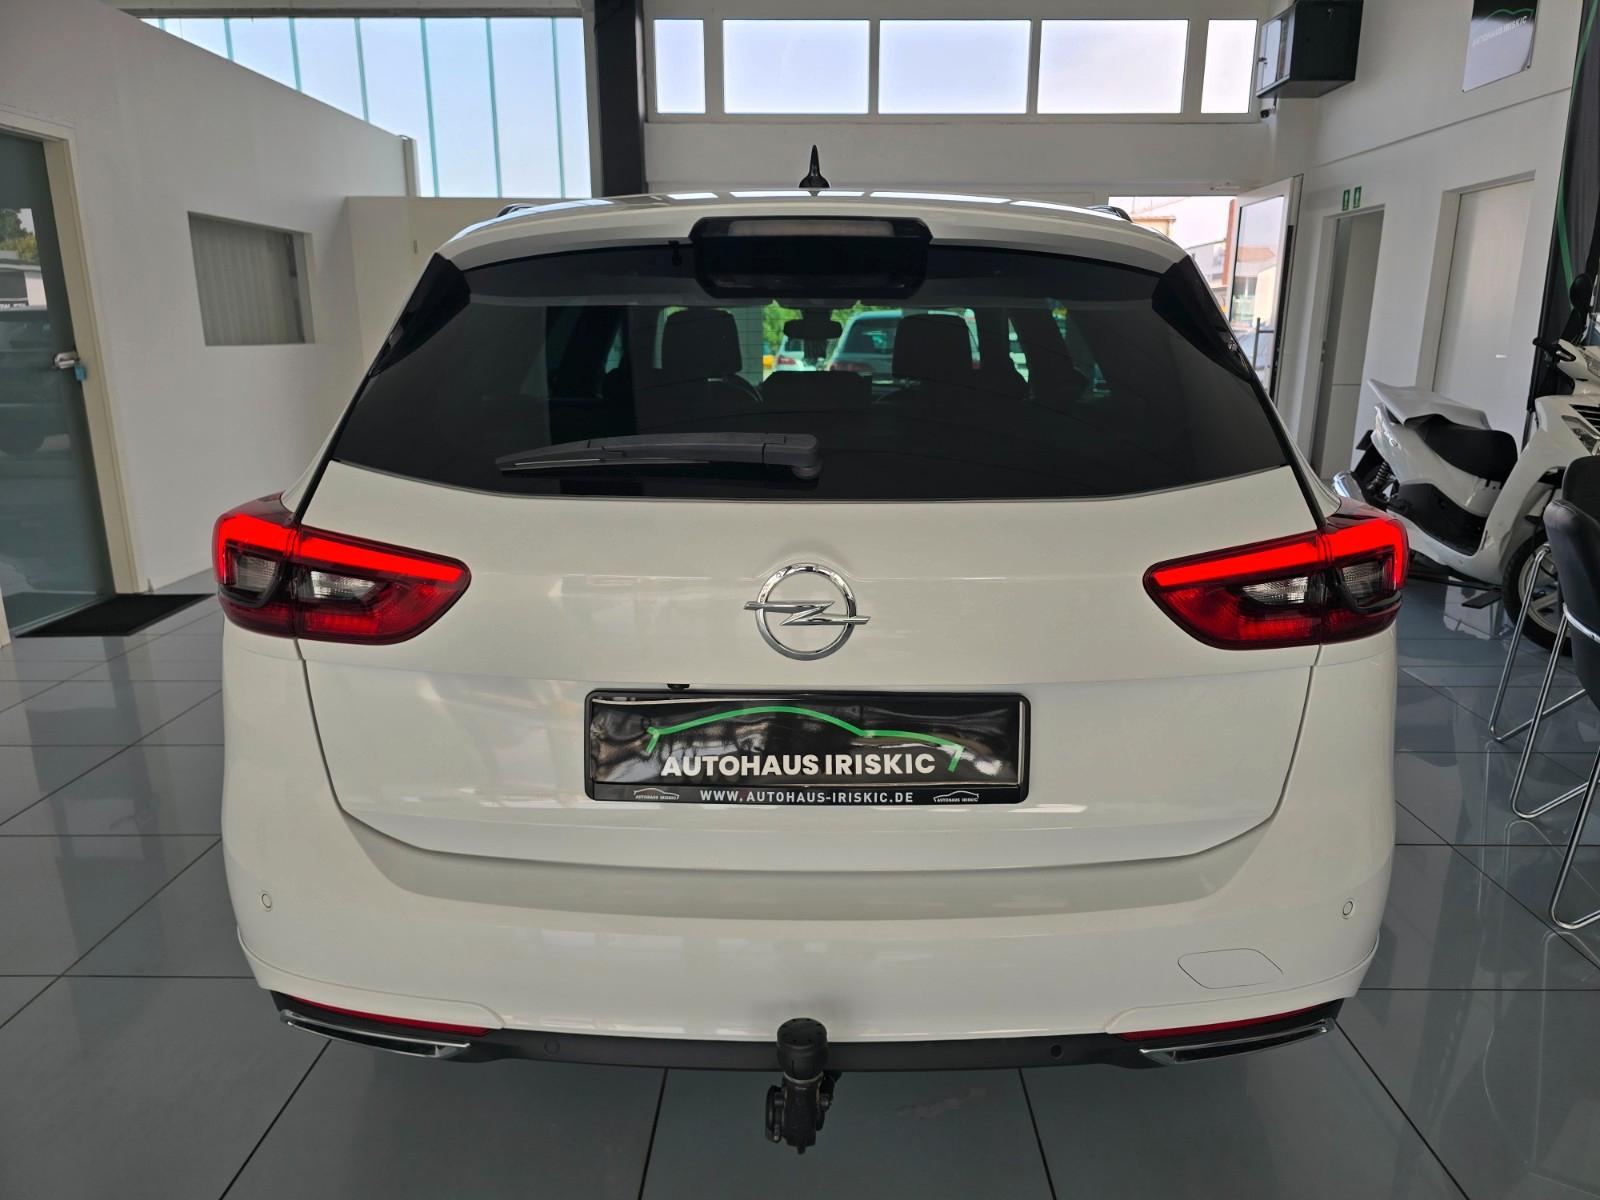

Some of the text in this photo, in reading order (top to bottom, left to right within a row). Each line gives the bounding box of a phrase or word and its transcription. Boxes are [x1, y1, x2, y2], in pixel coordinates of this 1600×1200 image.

[661, 753, 936, 777] AUTOHAUS IRISKIC
[700, 789, 914, 803] WWW.AUTOHAUS-IRISKIC.DE
